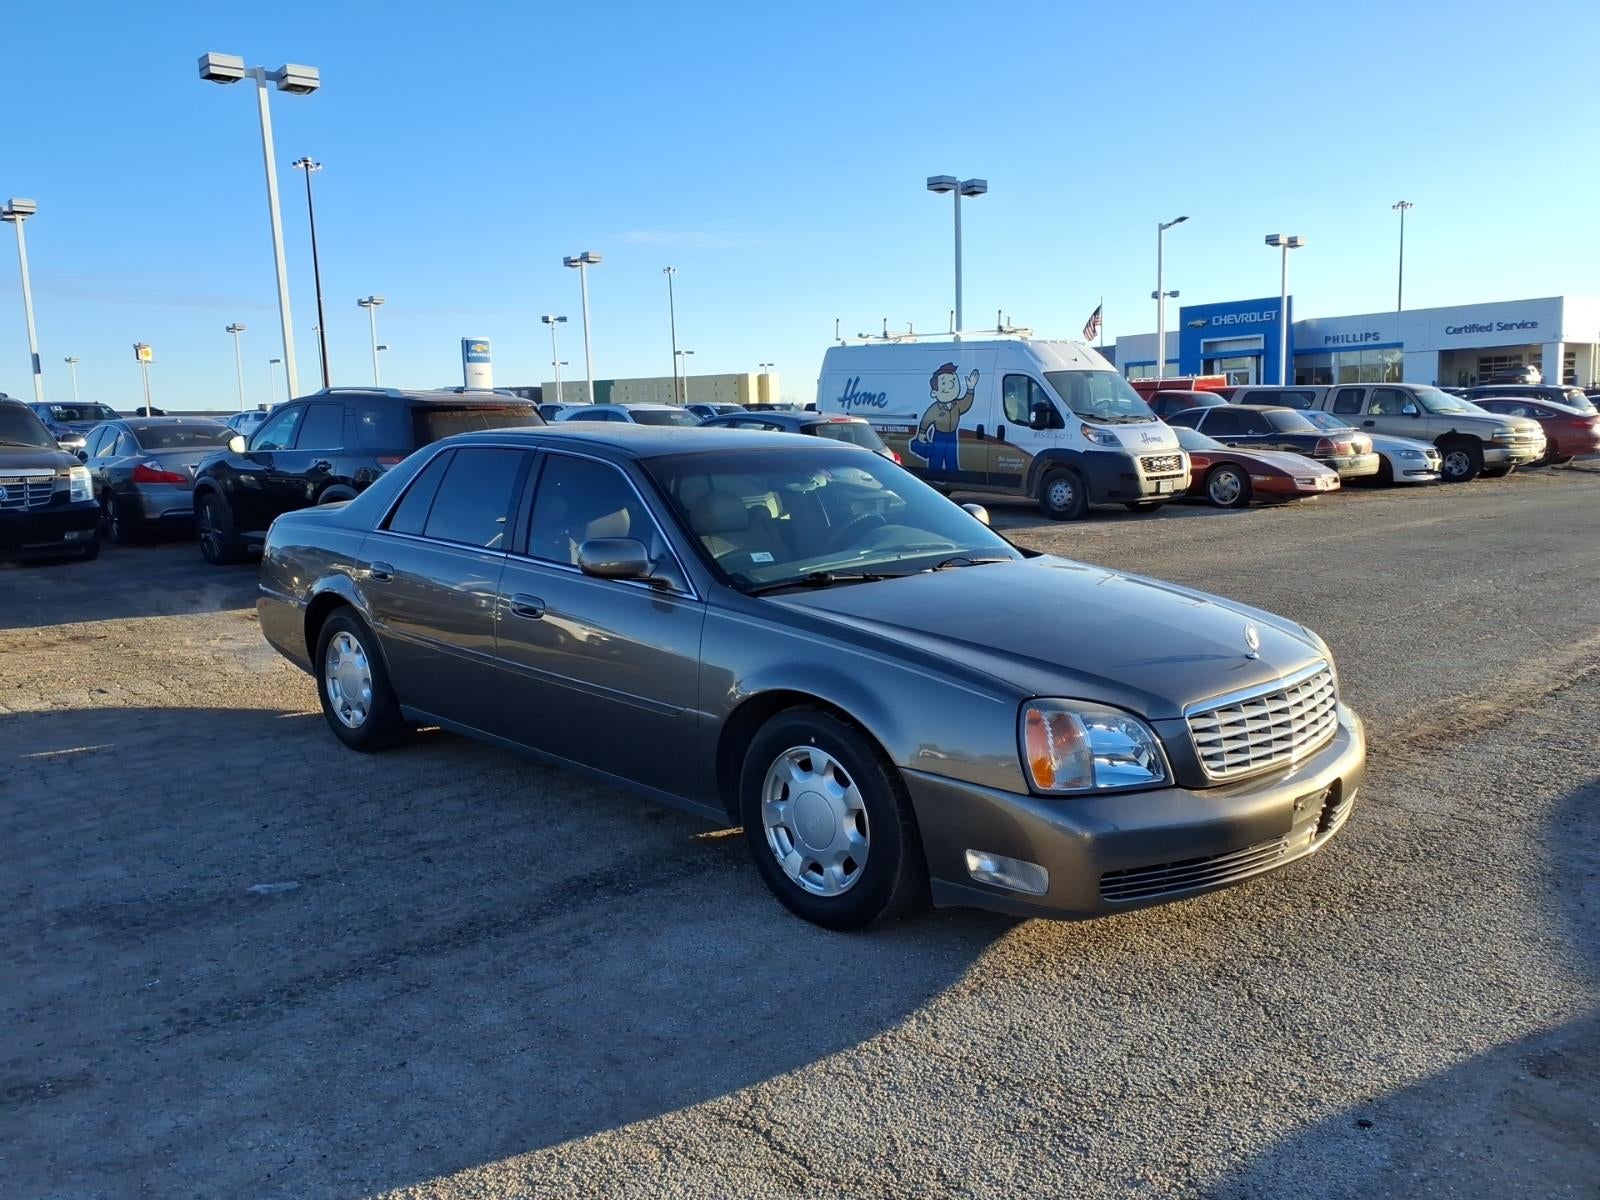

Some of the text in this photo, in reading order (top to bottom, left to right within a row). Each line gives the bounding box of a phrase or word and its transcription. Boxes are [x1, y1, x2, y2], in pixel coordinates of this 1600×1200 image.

[1212, 310, 1278, 326] CHEVROLET
[1445, 320, 1538, 336] Certified Service
[1324, 331, 1380, 345] PHILLIPS
[837, 376, 888, 410] Home
